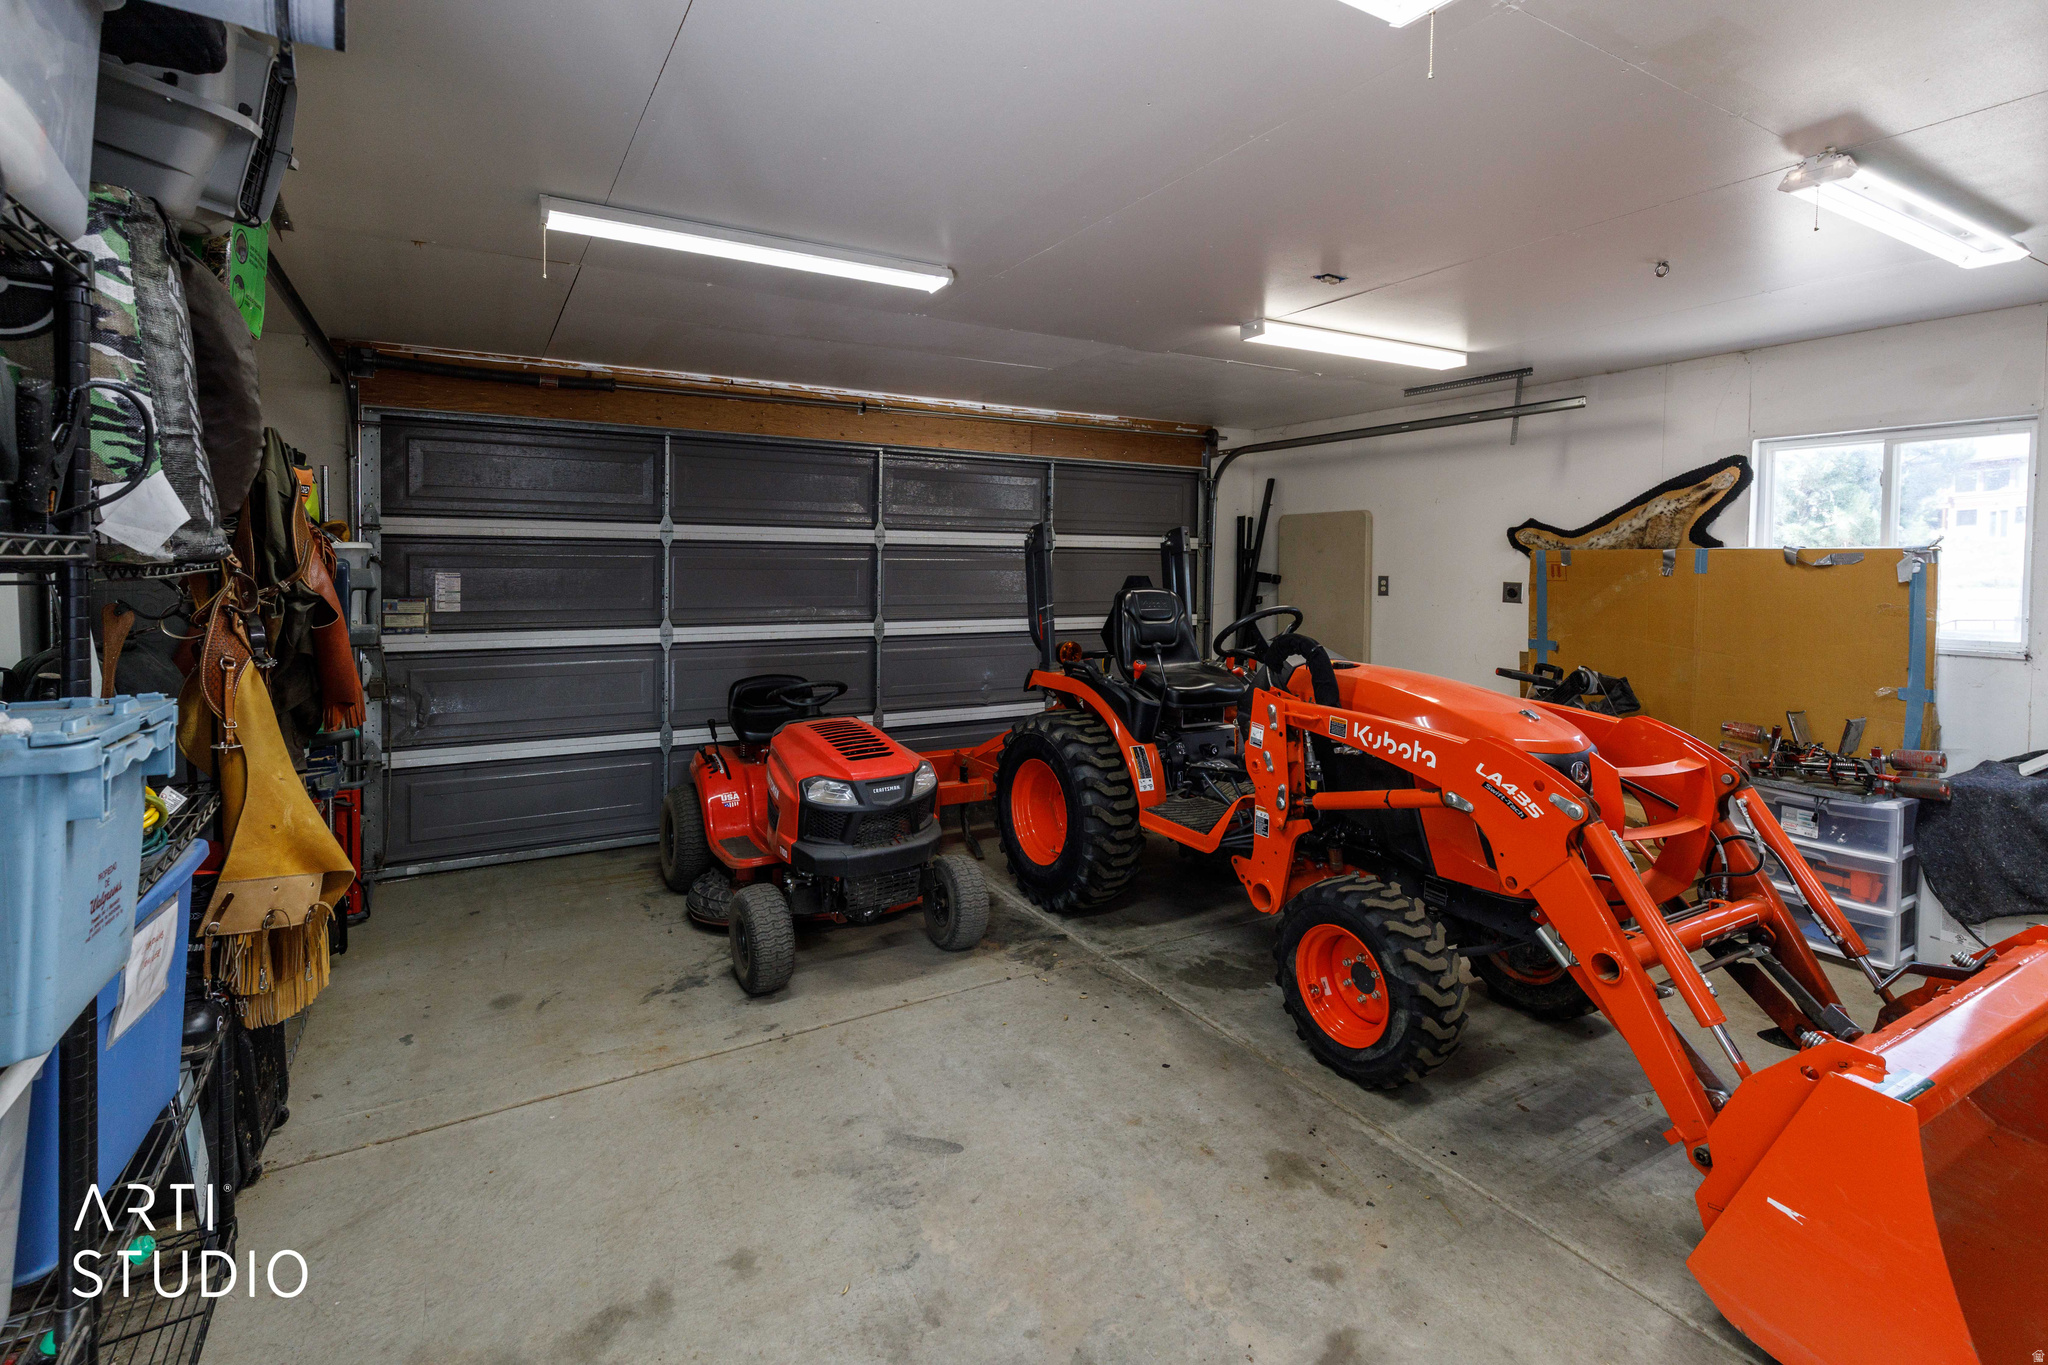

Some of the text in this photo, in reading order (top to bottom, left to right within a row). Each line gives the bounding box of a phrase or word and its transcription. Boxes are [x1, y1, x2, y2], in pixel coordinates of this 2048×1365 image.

[1353, 722, 1436, 768] Kubota
[720, 792, 740, 802] USA
[872, 785, 901, 794] CRAFTSMAN
[1475, 762, 1545, 819] LA435
[1484, 783, 1525, 818] Swift-Tach
[90, 880, 122, 915] Walgreens
